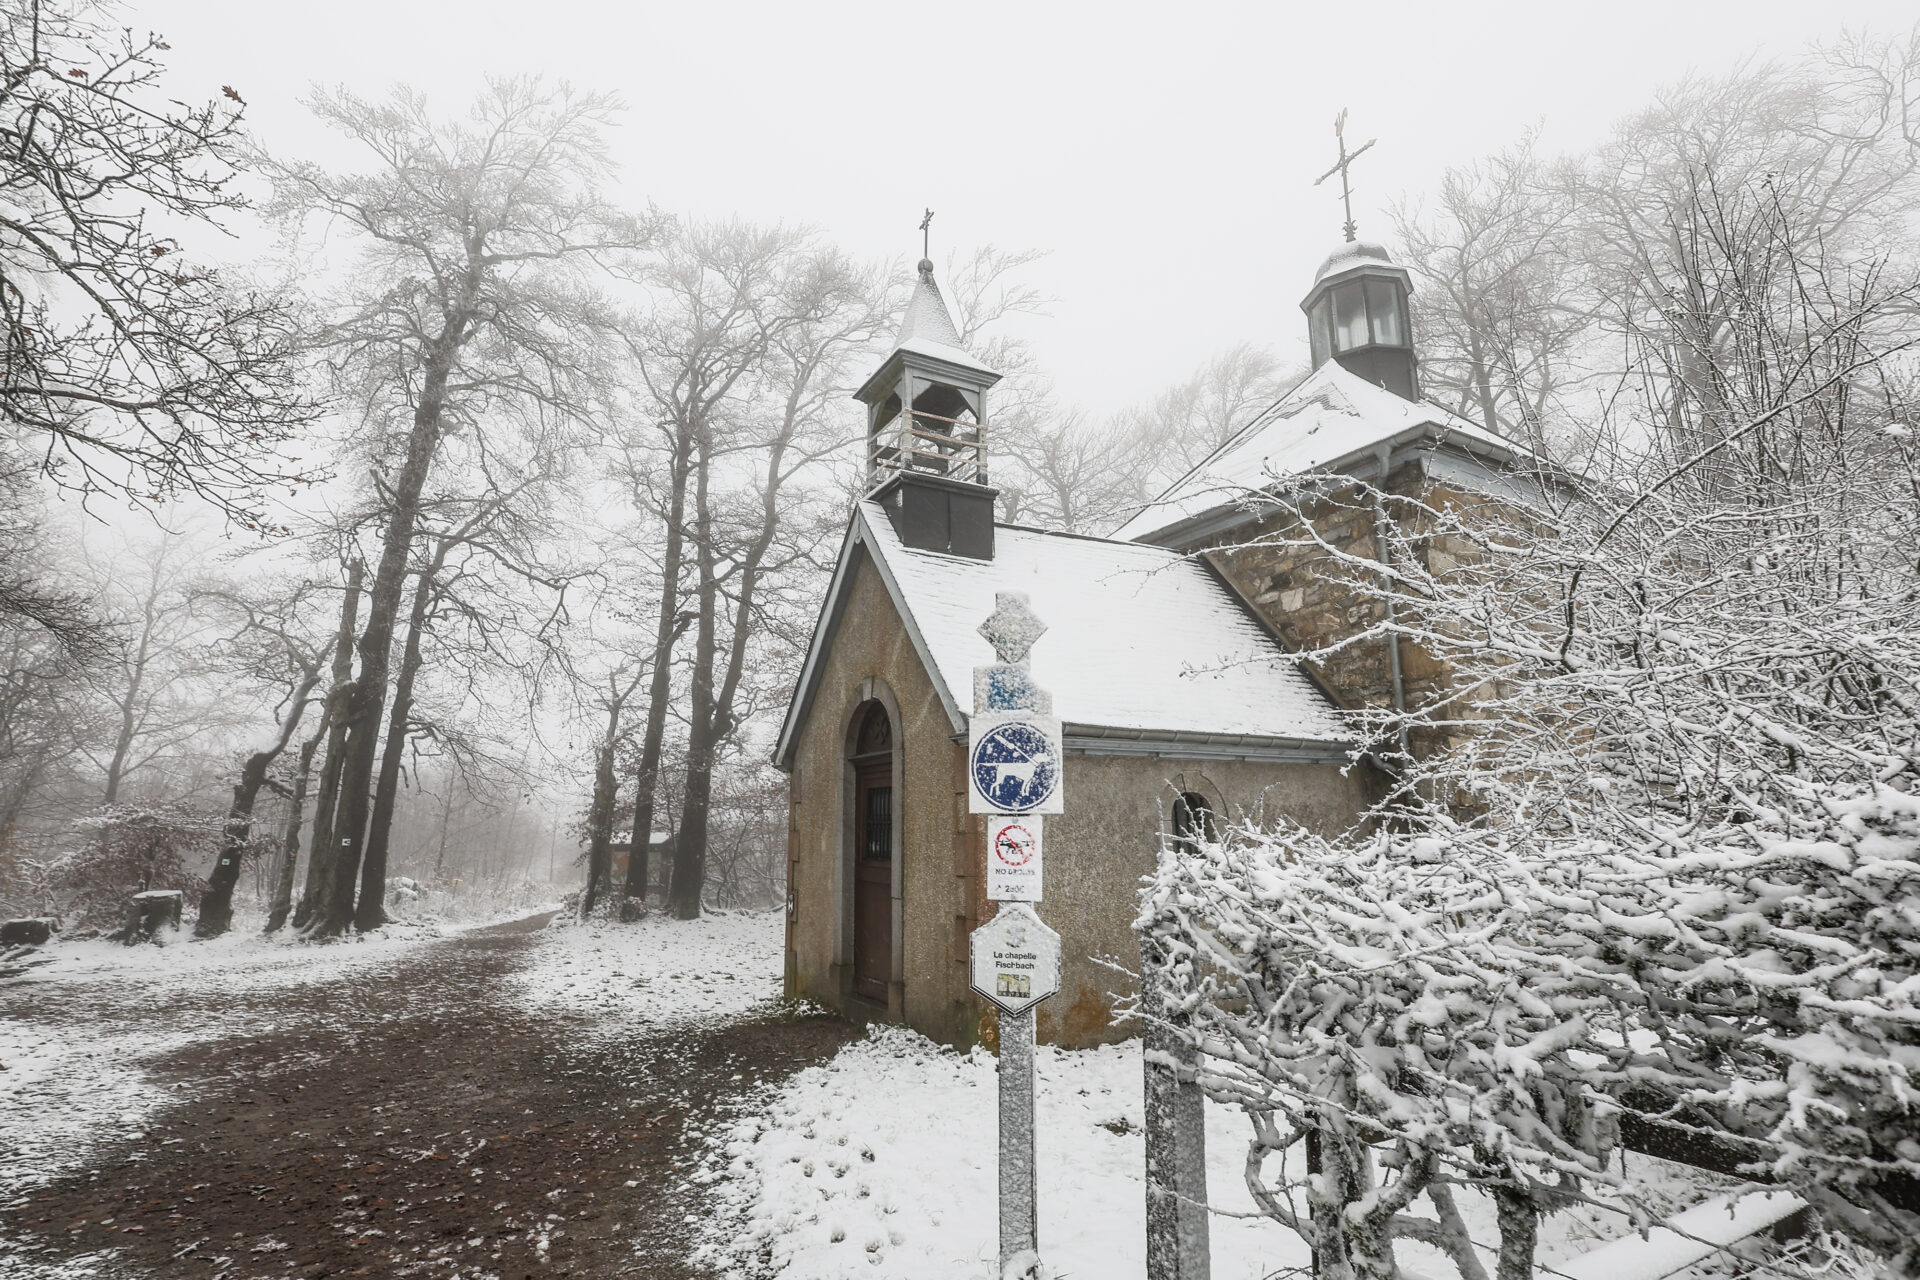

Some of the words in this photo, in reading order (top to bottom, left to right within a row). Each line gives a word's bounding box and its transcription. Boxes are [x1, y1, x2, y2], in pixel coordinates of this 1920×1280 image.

[1008, 868, 1035, 876] DROS
[993, 951, 1003, 959] La
[1004, 952, 1037, 960] chapelle
[995, 961, 1035, 970] Fischbach
